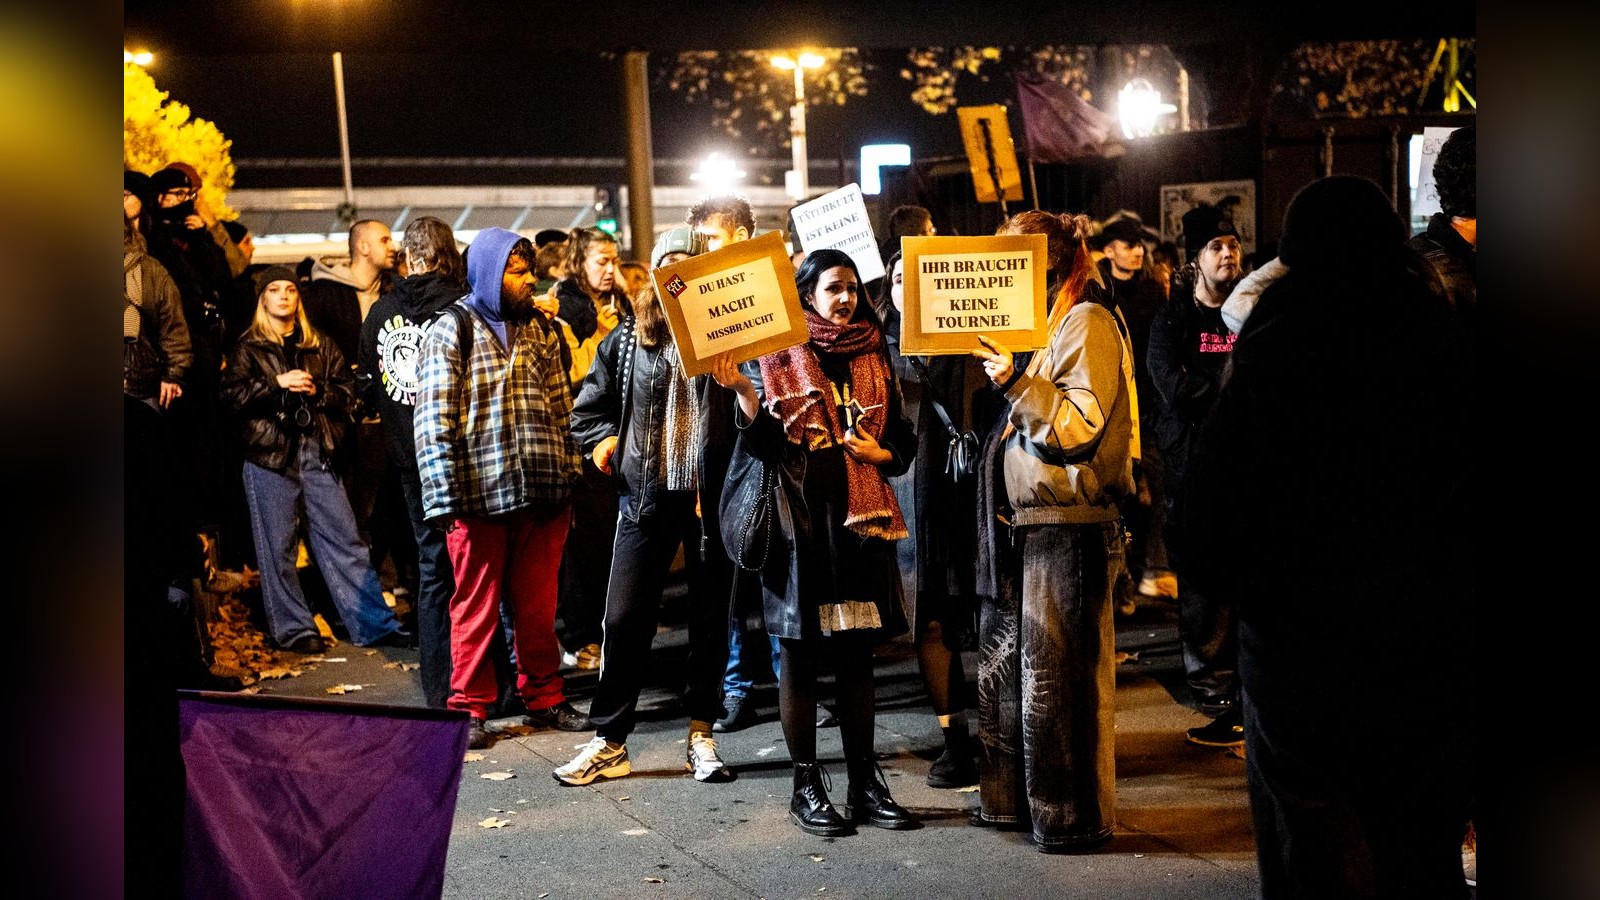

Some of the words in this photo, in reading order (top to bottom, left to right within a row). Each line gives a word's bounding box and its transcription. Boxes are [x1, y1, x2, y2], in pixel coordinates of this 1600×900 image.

[797, 193, 855, 223] TÄTERKULT
[824, 212, 860, 233] KEINE
[922, 261, 950, 274] IHR
[954, 258, 1028, 273] BRAUCHT
[666, 277, 681, 291] FCK
[698, 281, 715, 295] DU
[716, 272, 746, 290] HAST
[934, 275, 1014, 290] THERAPIE
[708, 295, 756, 320] MACHT
[949, 298, 999, 311] KEINE
[706, 313, 775, 342] MISSBRAUCHT
[936, 314, 1010, 329] TOURNEE
